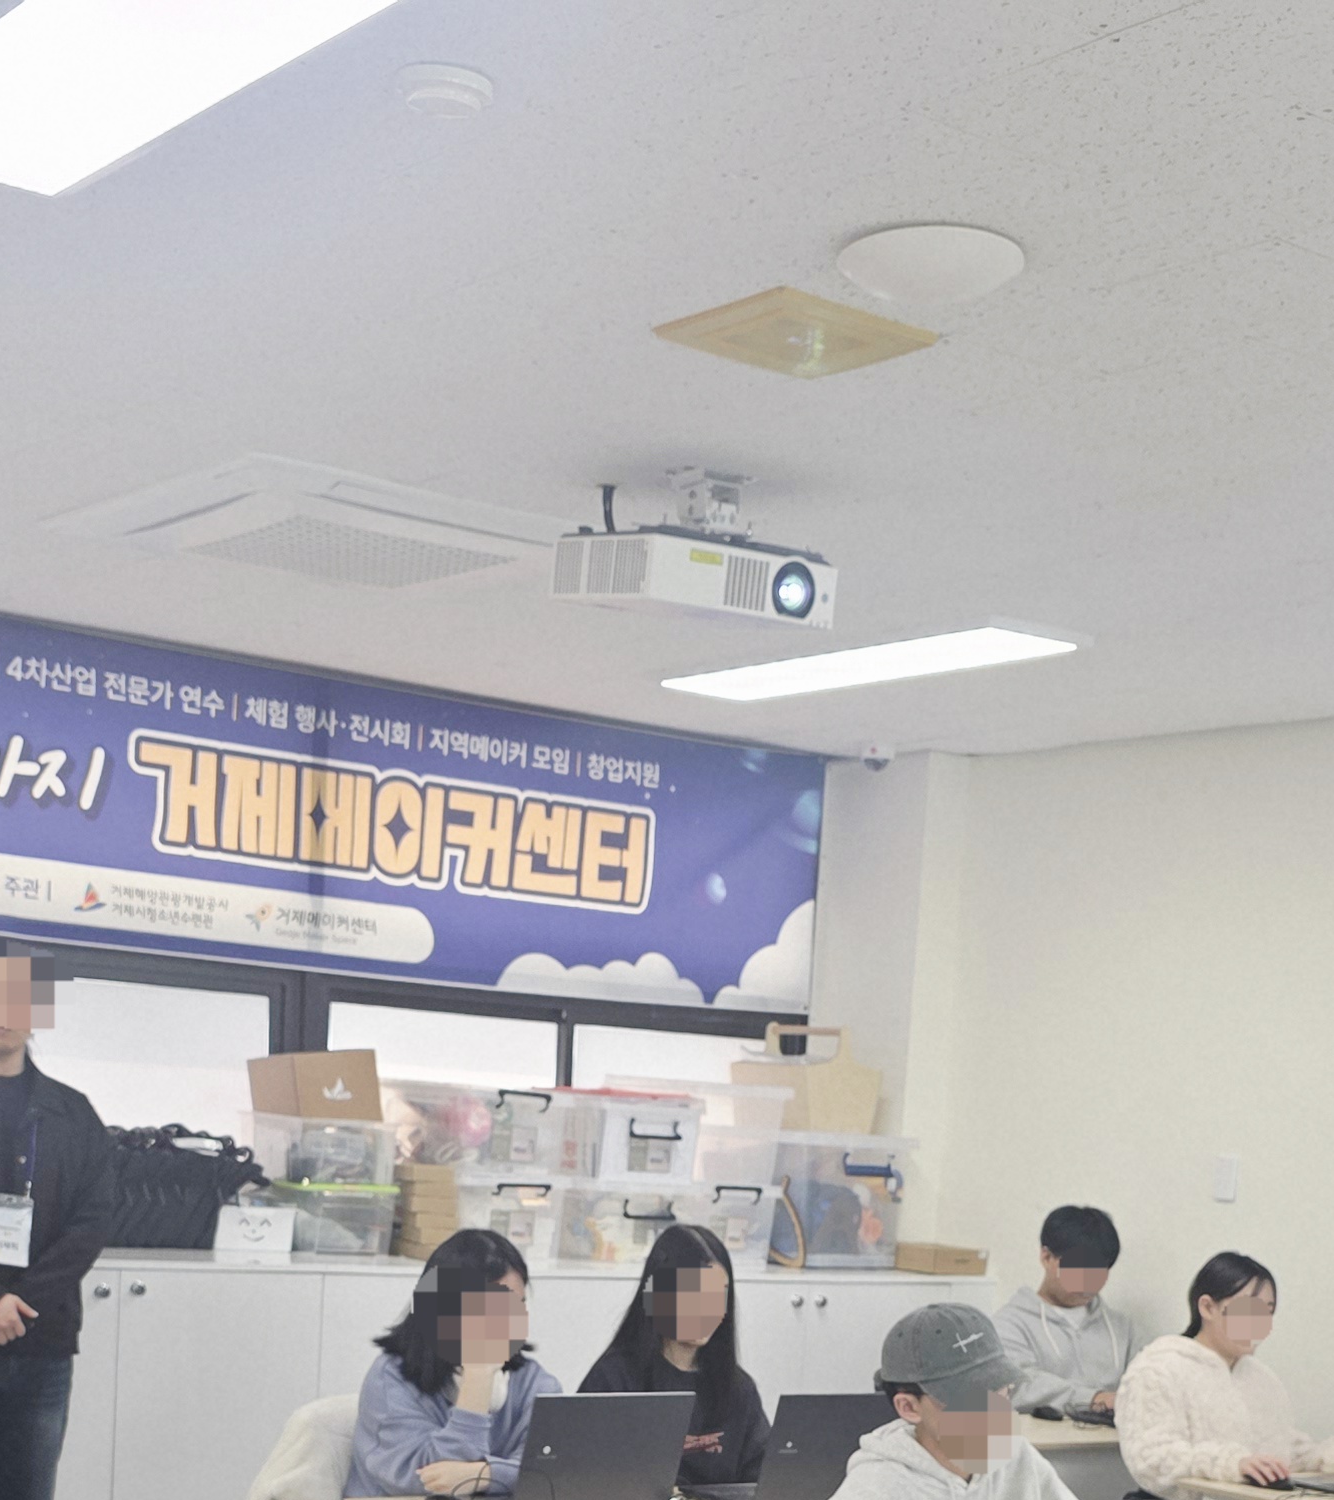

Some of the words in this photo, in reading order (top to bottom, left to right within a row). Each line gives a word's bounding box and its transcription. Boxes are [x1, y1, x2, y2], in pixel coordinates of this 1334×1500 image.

[6, 656, 96, 697] 4차산업
[103, 671, 173, 710] 전문가
[178, 685, 225, 719] 연수
[244, 696, 289, 730] 체험
[429, 726, 527, 769] 지역메이커
[532, 744, 569, 775] 모임
[587, 753, 660, 788] 창업지원
[133, 734, 652, 909] 거제메이커센터
[4, 876, 40, 898] 주관
[276, 907, 378, 936] 거제메이커센터
